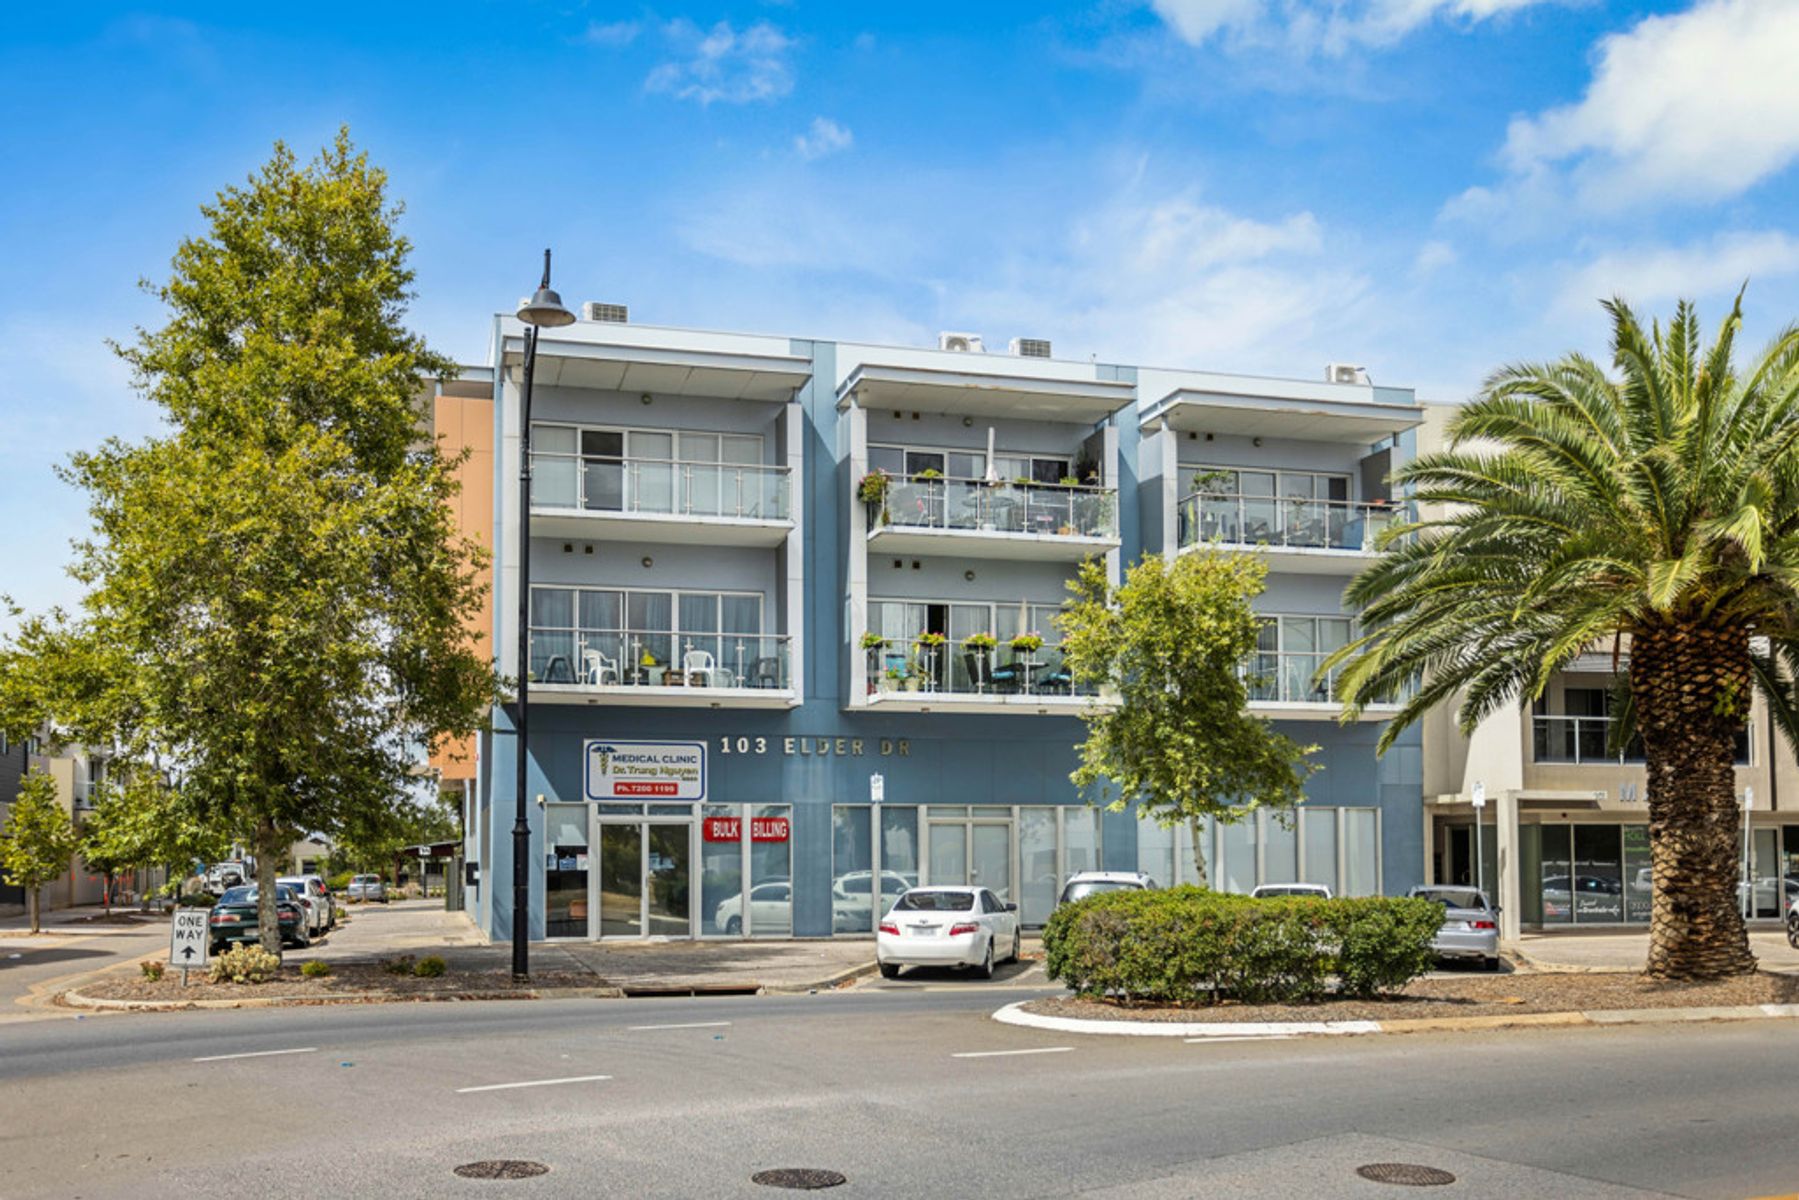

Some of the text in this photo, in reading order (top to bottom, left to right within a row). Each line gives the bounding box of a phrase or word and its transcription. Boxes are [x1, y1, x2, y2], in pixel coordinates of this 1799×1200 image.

[721, 737, 910, 755] 103 ELDER DR
[612, 754, 697, 764] MEDICAL CLINIC
[659, 766, 699, 777] Nguyen
[713, 821, 787, 838] BULK BILLING
[178, 915, 203, 927] ONE
[176, 929, 203, 939] WAY
